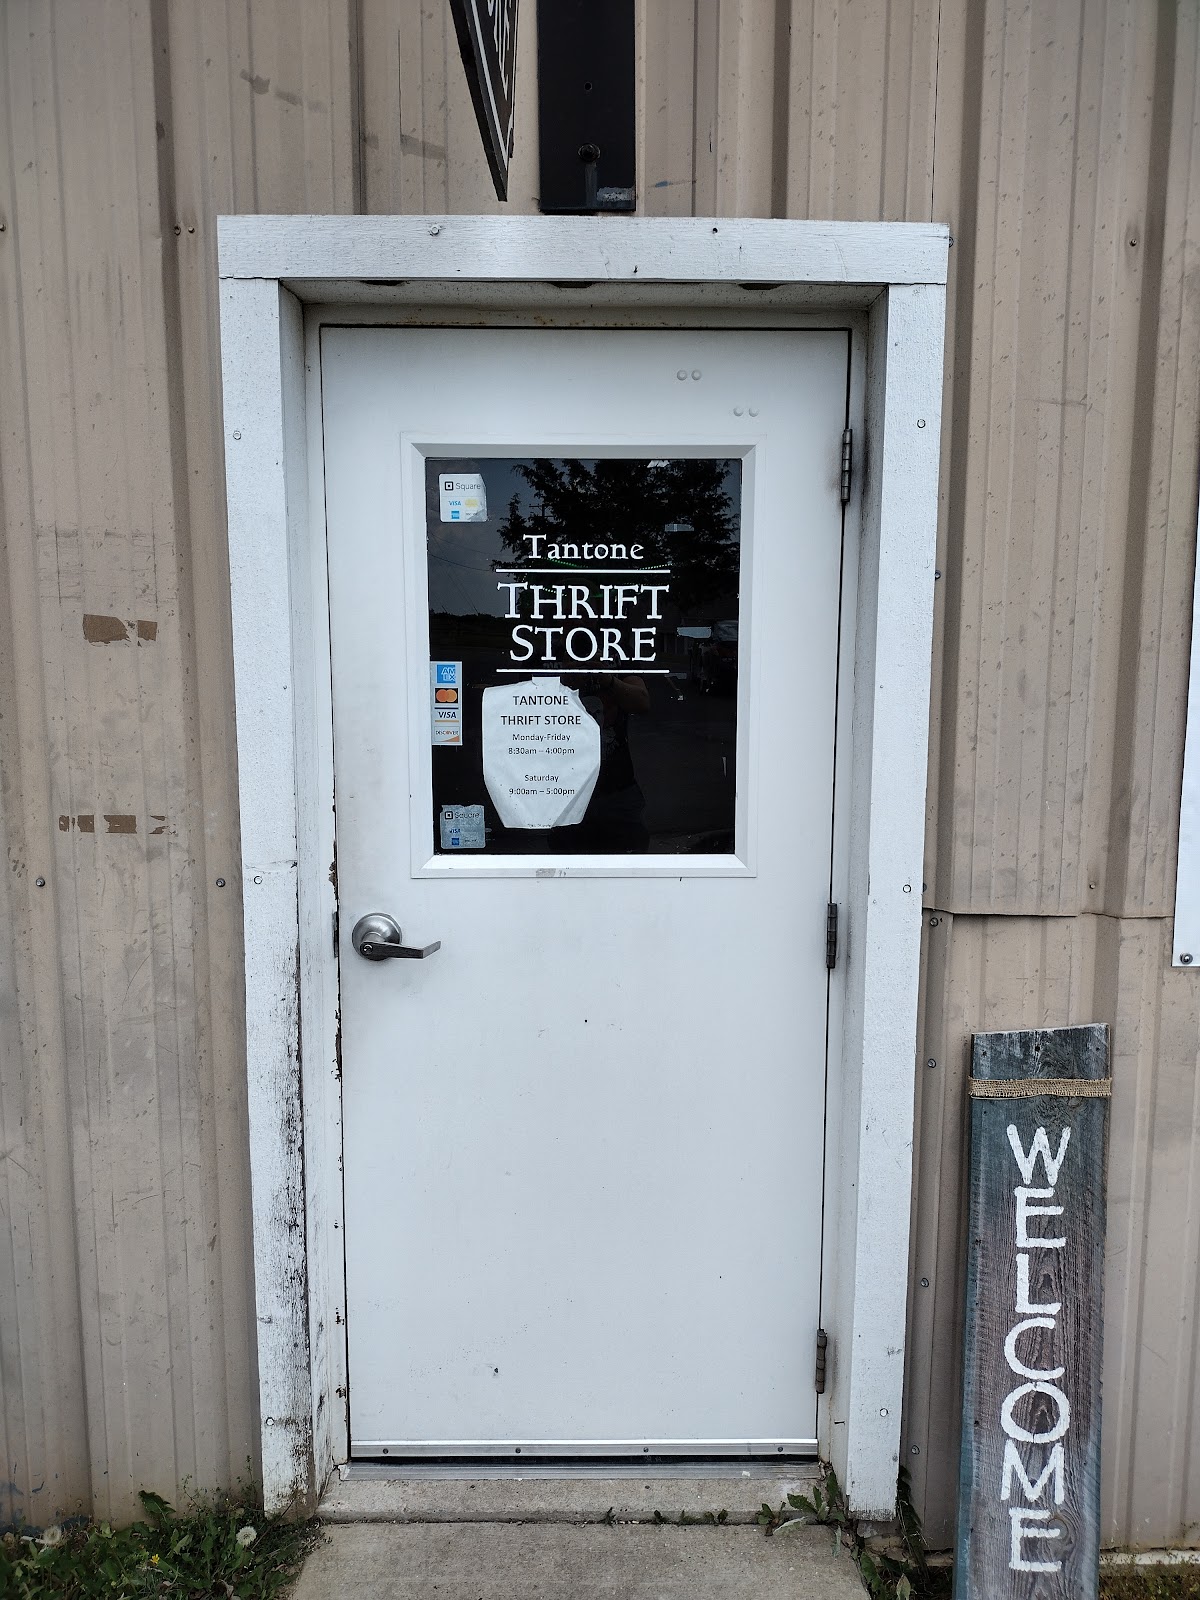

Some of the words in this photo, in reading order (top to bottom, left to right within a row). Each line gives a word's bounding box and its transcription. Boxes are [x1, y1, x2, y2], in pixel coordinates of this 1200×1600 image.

[455, 482, 481, 491] Square
[523, 534, 644, 560] Tantone
[496, 582, 670, 620] THRIFT
[510, 625, 657, 661] STORE
[513, 695, 569, 706] TANTONE
[438, 711, 457, 719] VISA
[500, 715, 541, 725] THRIFT
[544, 715, 581, 725] STORE
[512, 733, 571, 742] Monday-Friday
[508, 747, 537, 755] 8:30am
[545, 747, 575, 755] 4:00pm
[524, 774, 559, 782] Saturday
[546, 788, 575, 796] 5:00pm
[455, 811, 480, 819] Square
[1000, 1124, 1071, 1573] WELCOME
